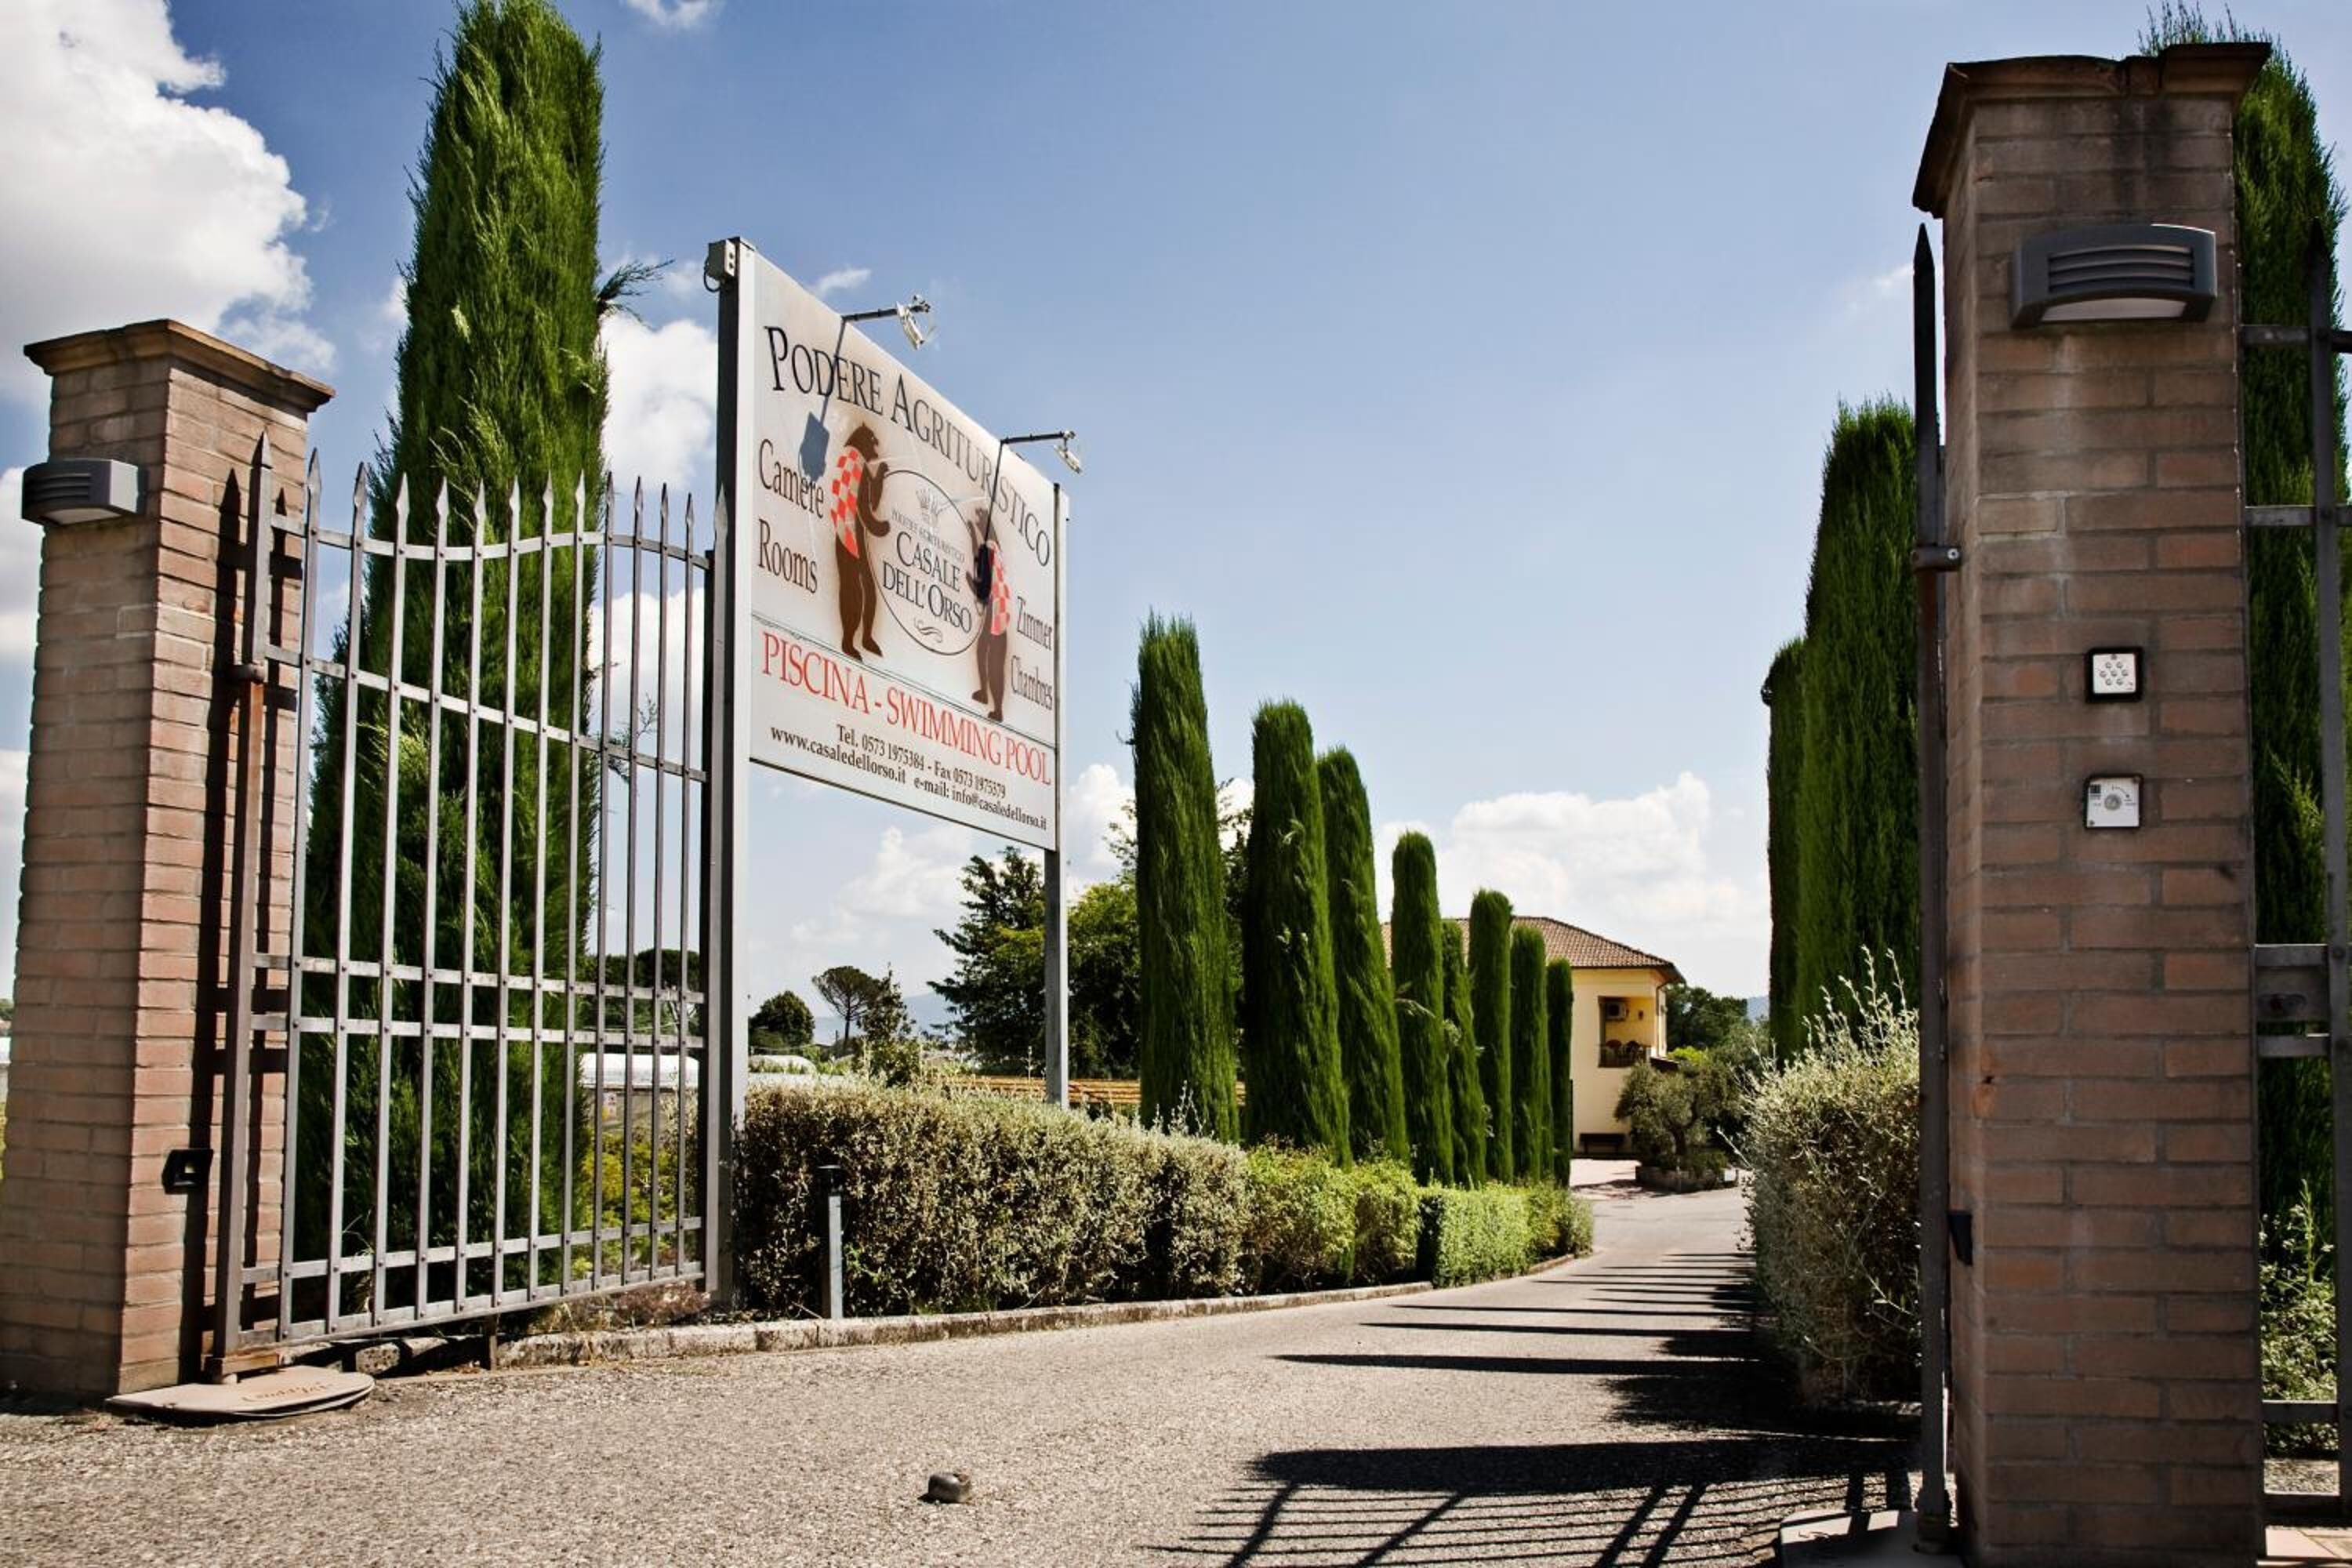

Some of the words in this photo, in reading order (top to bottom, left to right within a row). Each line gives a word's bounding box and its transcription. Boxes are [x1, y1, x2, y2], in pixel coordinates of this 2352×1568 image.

[758, 438, 825, 519] Camere
[764, 325, 884, 416] PODERE
[891, 372, 1050, 567] AGRITURSTICO
[758, 518, 818, 594] Rooms
[896, 531, 960, 592] CASALE
[1015, 594, 1053, 652] Zimmer
[762, 631, 869, 715] PISCINA
[887, 686, 1001, 766] SWIMMING
[1005, 737, 1051, 786] POOL
[1010, 655, 1053, 711] Chambres
[771, 727, 906, 784] www.casaledellorso.it
[913, 776, 949, 798] e-mail:
[952, 785, 1047, 830] info@casaledellorso.it
[837, 724, 858, 747] Tel.
[862, 734, 885, 757] 0573
[888, 743, 924, 771] 1975384
[935, 760, 951, 780] Fax
[953, 768, 973, 788] 0573
